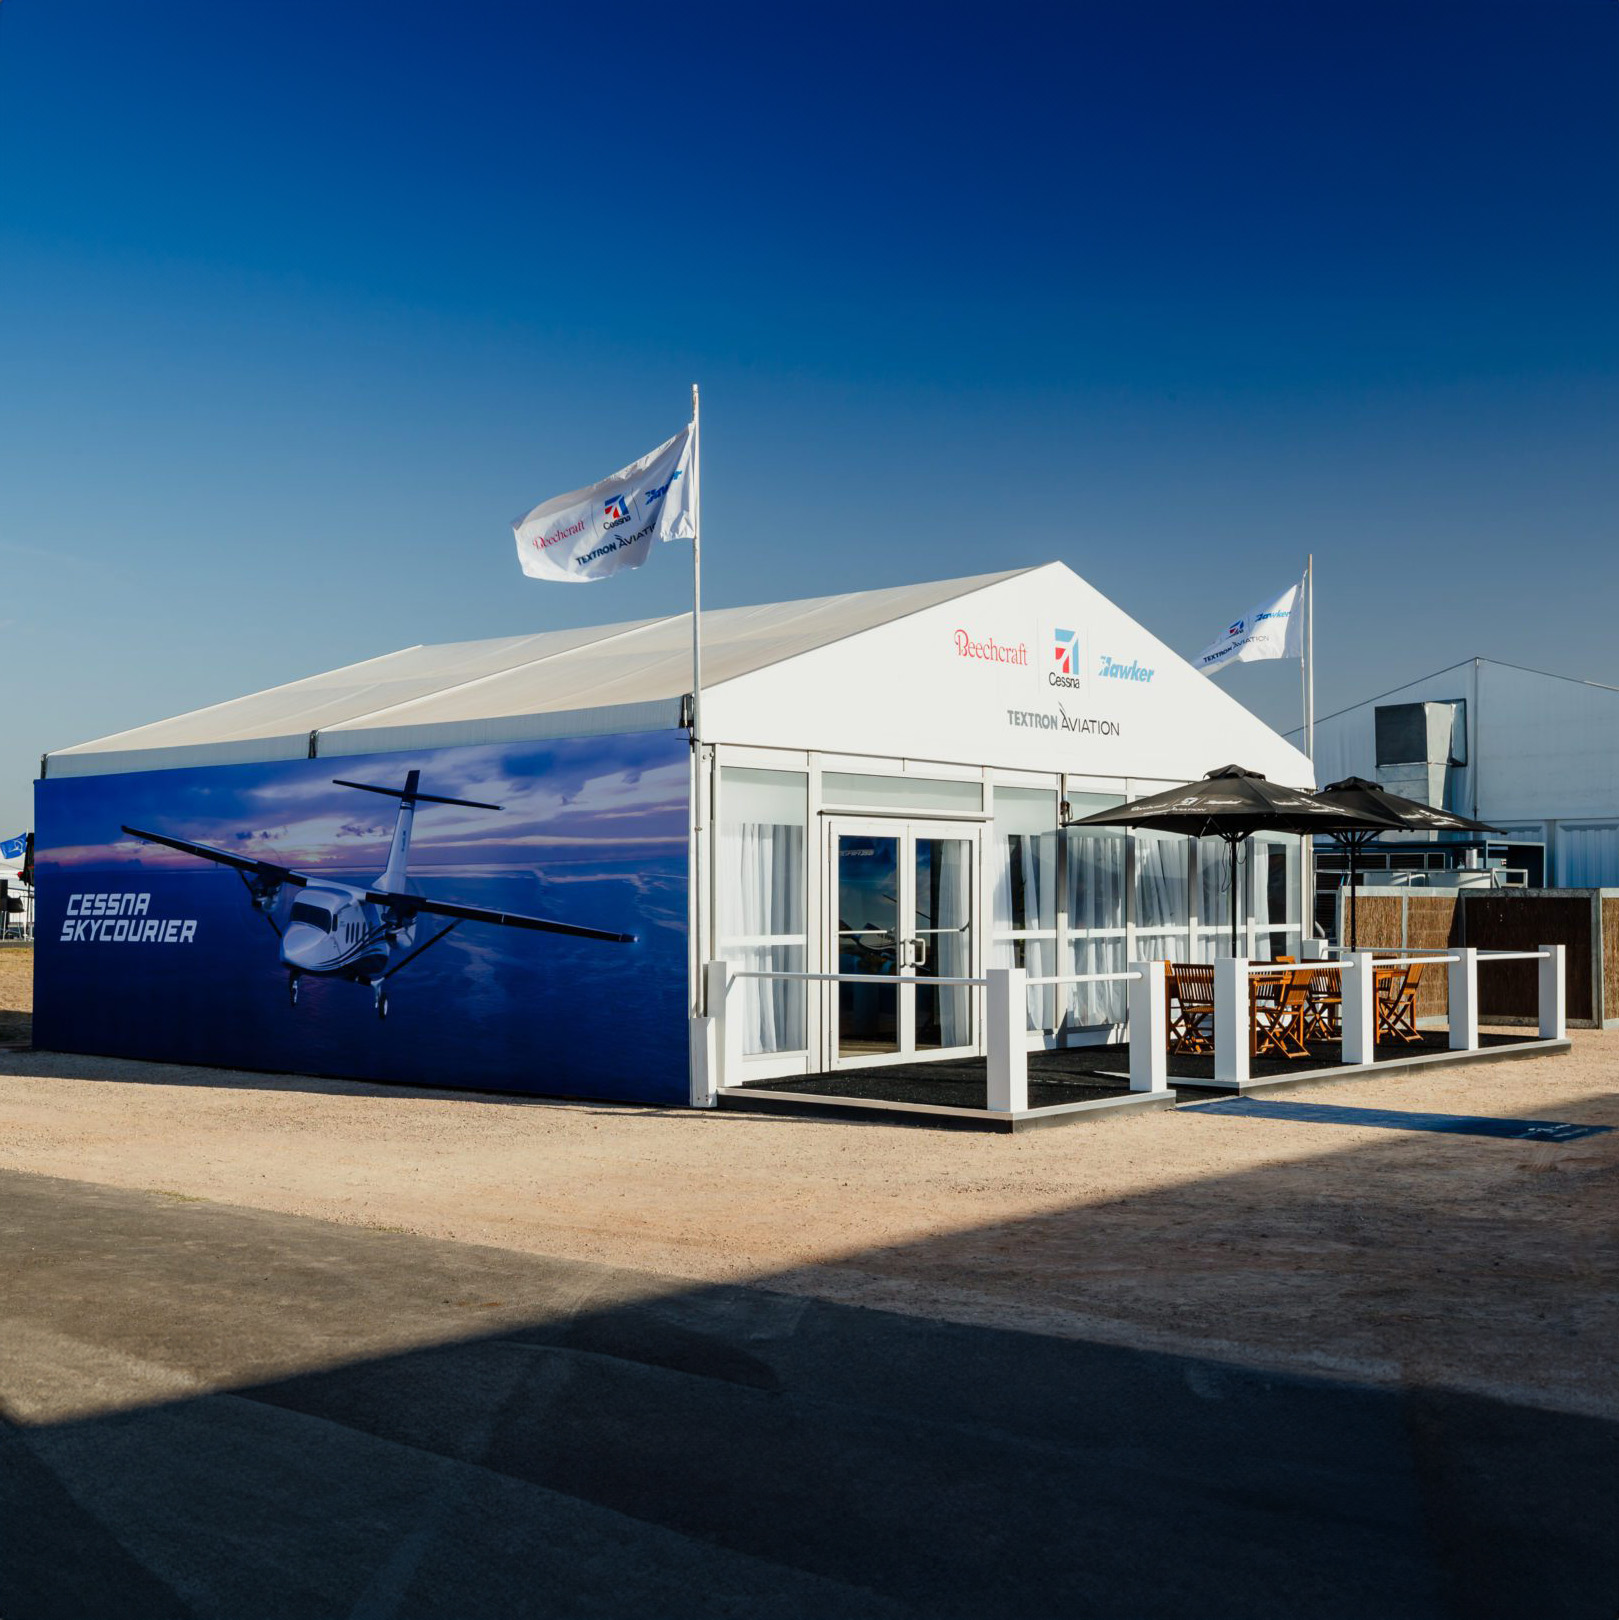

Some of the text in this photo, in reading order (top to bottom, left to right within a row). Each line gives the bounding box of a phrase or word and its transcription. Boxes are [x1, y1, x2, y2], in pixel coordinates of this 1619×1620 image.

[603, 515, 632, 531] Cessna
[575, 522, 657, 566] TEXTRON AVIATI
[954, 629, 1028, 666] Beechcraft
[1049, 672, 1080, 689] Cessna
[1099, 655, 1155, 683] Hawker
[1007, 701, 1120, 736] TEXTRON AVIATION
[66, 893, 151, 916] CESSNA
[60, 919, 198, 943] SKYCOURIER
